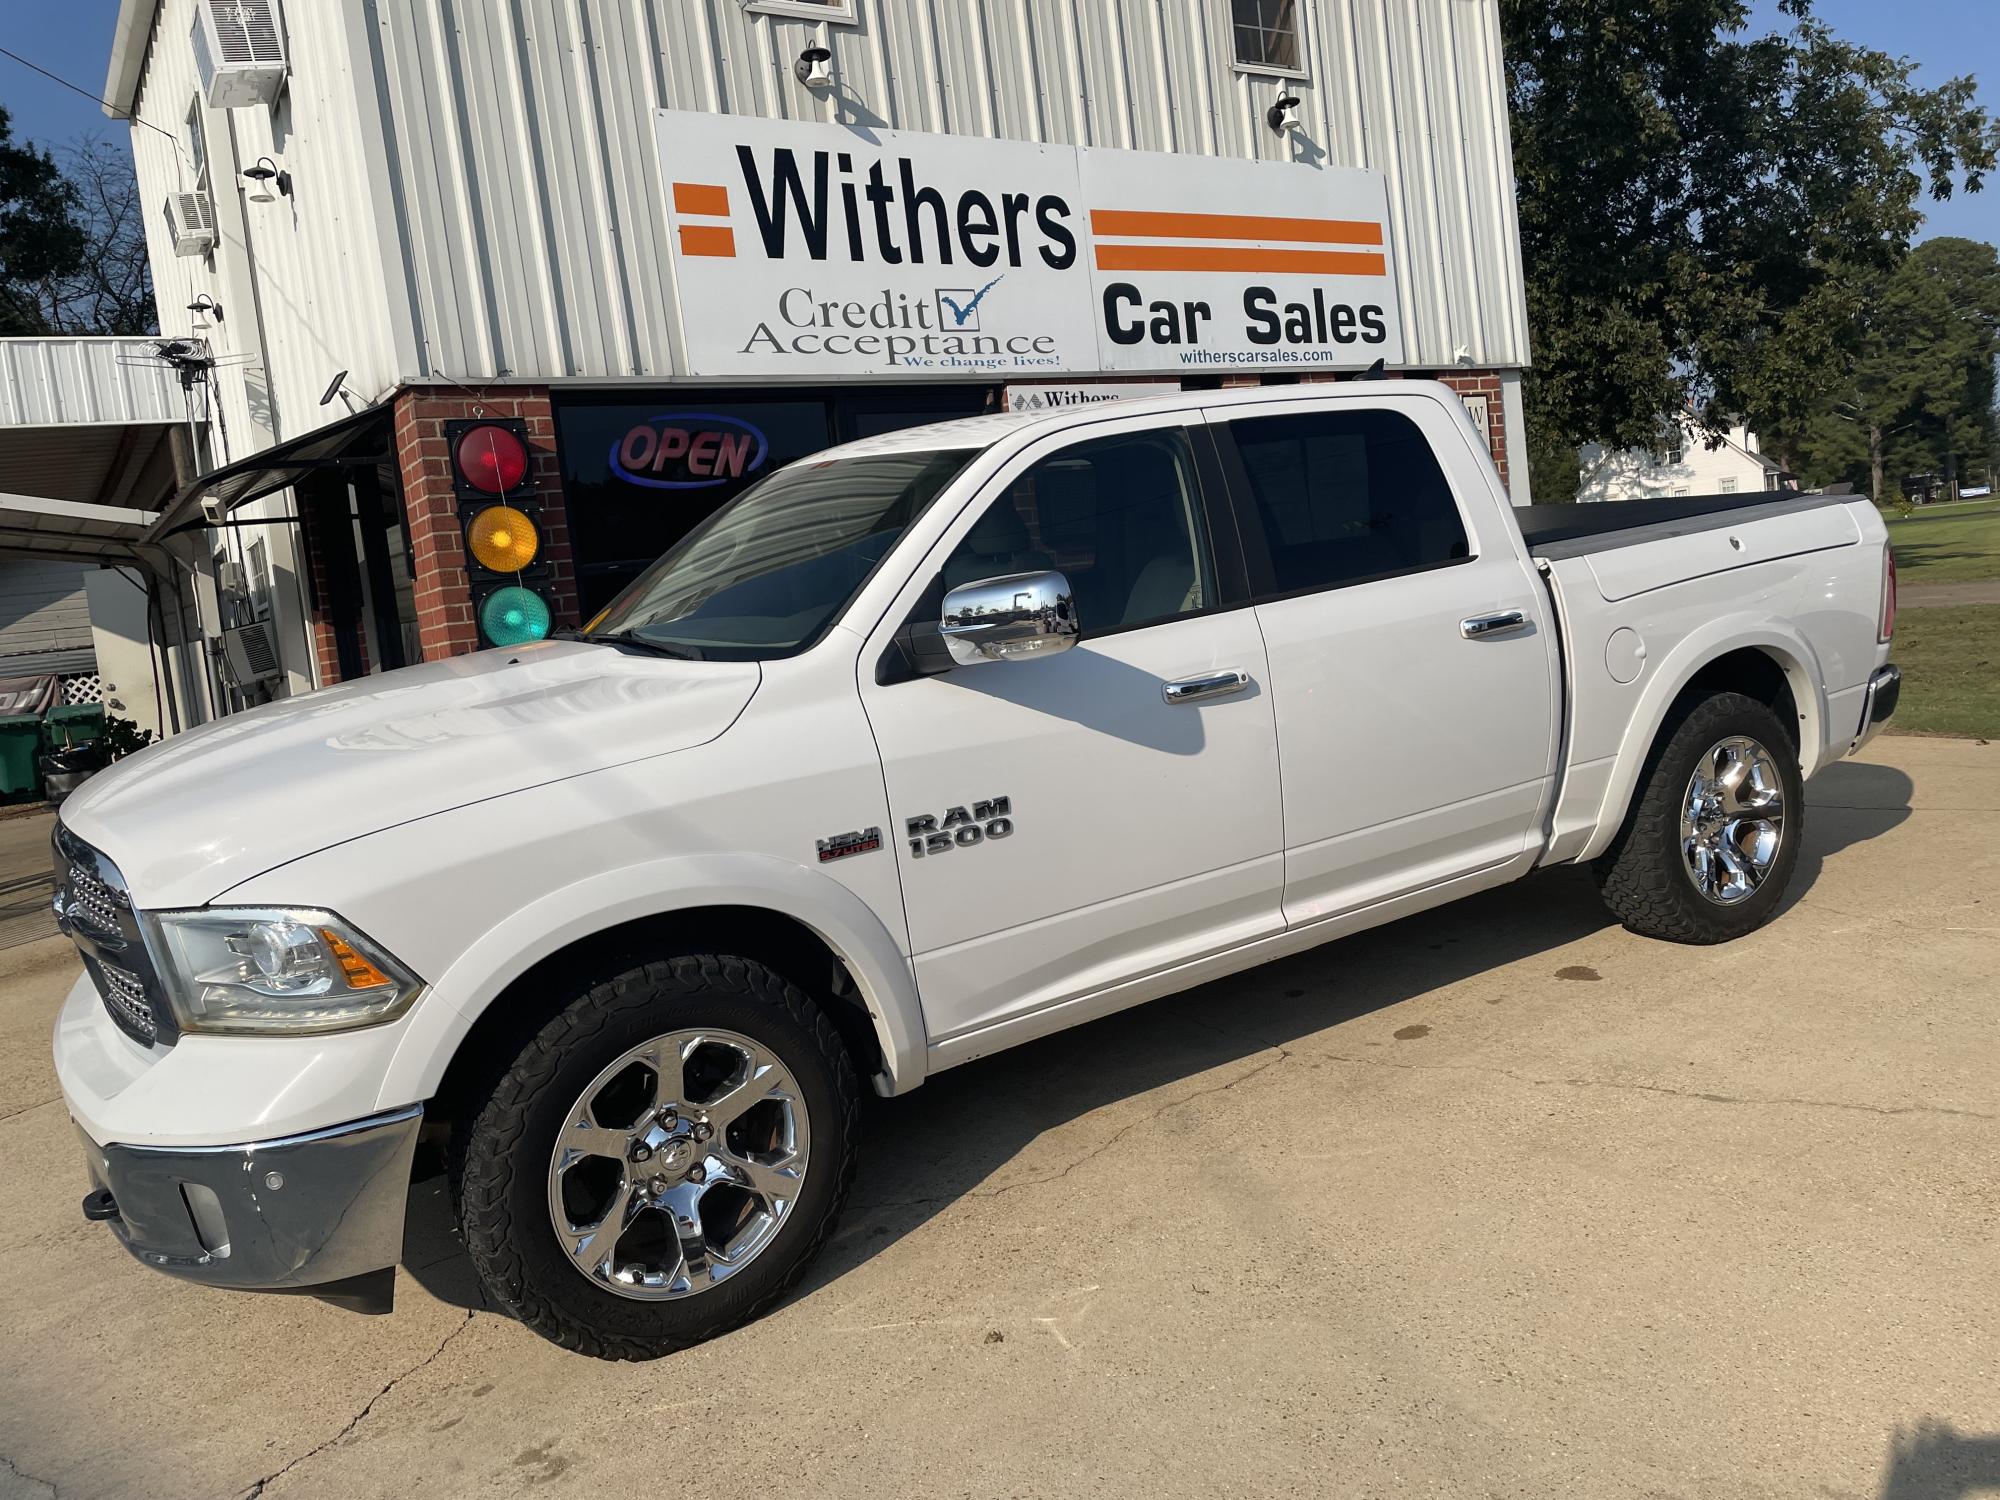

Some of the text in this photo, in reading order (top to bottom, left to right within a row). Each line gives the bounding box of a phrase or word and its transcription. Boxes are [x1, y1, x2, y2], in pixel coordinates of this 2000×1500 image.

[735, 145, 1078, 270] Withers
[779, 288, 933, 330] Credit
[1103, 282, 1387, 345] Car Sales
[737, 322, 1056, 366] Acceptance
[903, 356, 1061, 369] We change lives!
[1180, 349, 1333, 364] witherscarsales.com
[620, 425, 752, 478] OPEN
[905, 796, 1012, 838] RAM
[909, 818, 1014, 859] 1500
